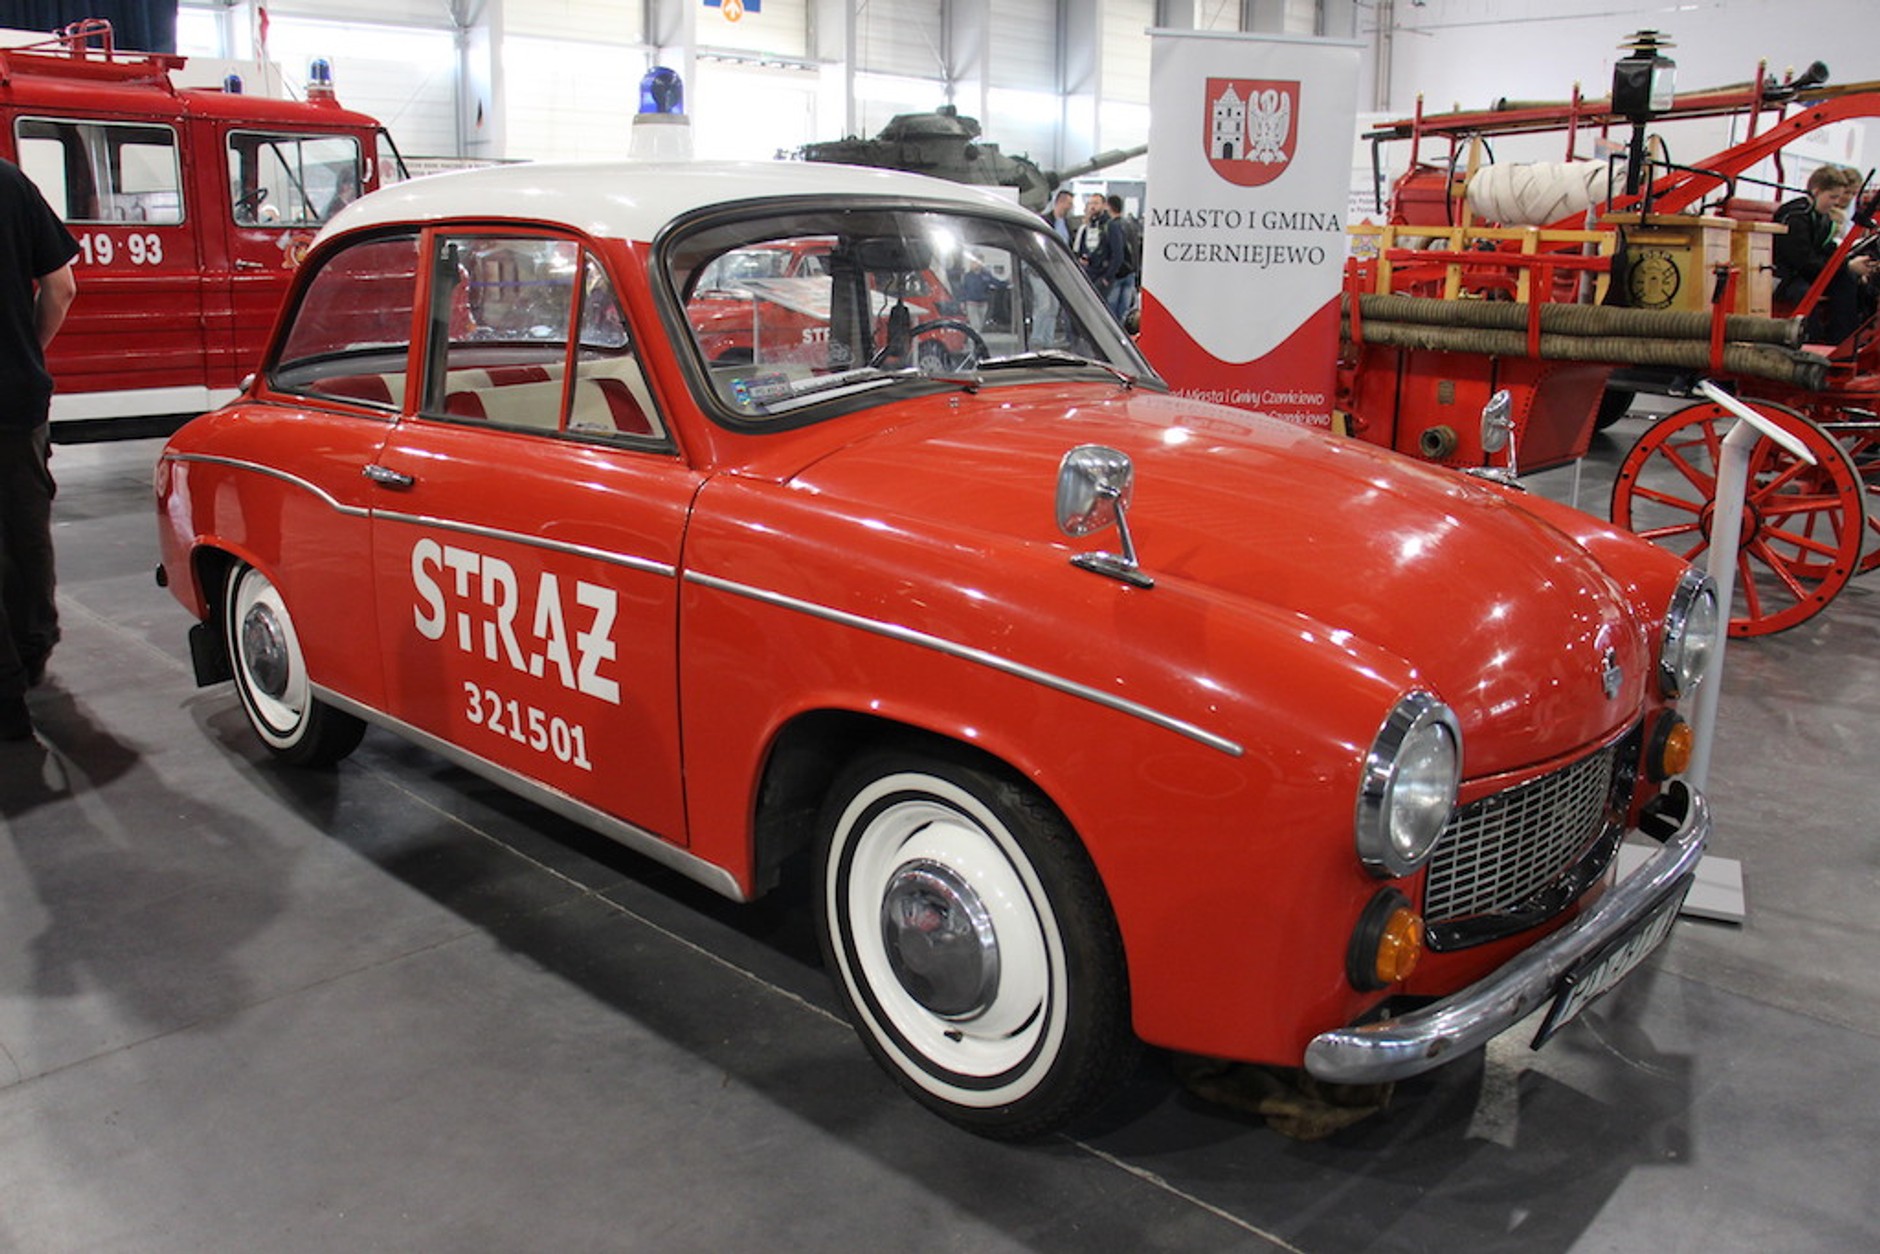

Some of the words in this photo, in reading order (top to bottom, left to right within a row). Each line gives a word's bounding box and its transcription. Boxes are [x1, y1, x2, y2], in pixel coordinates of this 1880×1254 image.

[1150, 207, 1242, 229] MIASTO
[1248, 210, 1255, 229] I
[1261, 210, 1341, 232] GMINA
[1163, 242, 1325, 270] CZERNIEJEWO
[463, 681, 593, 771] 321501
